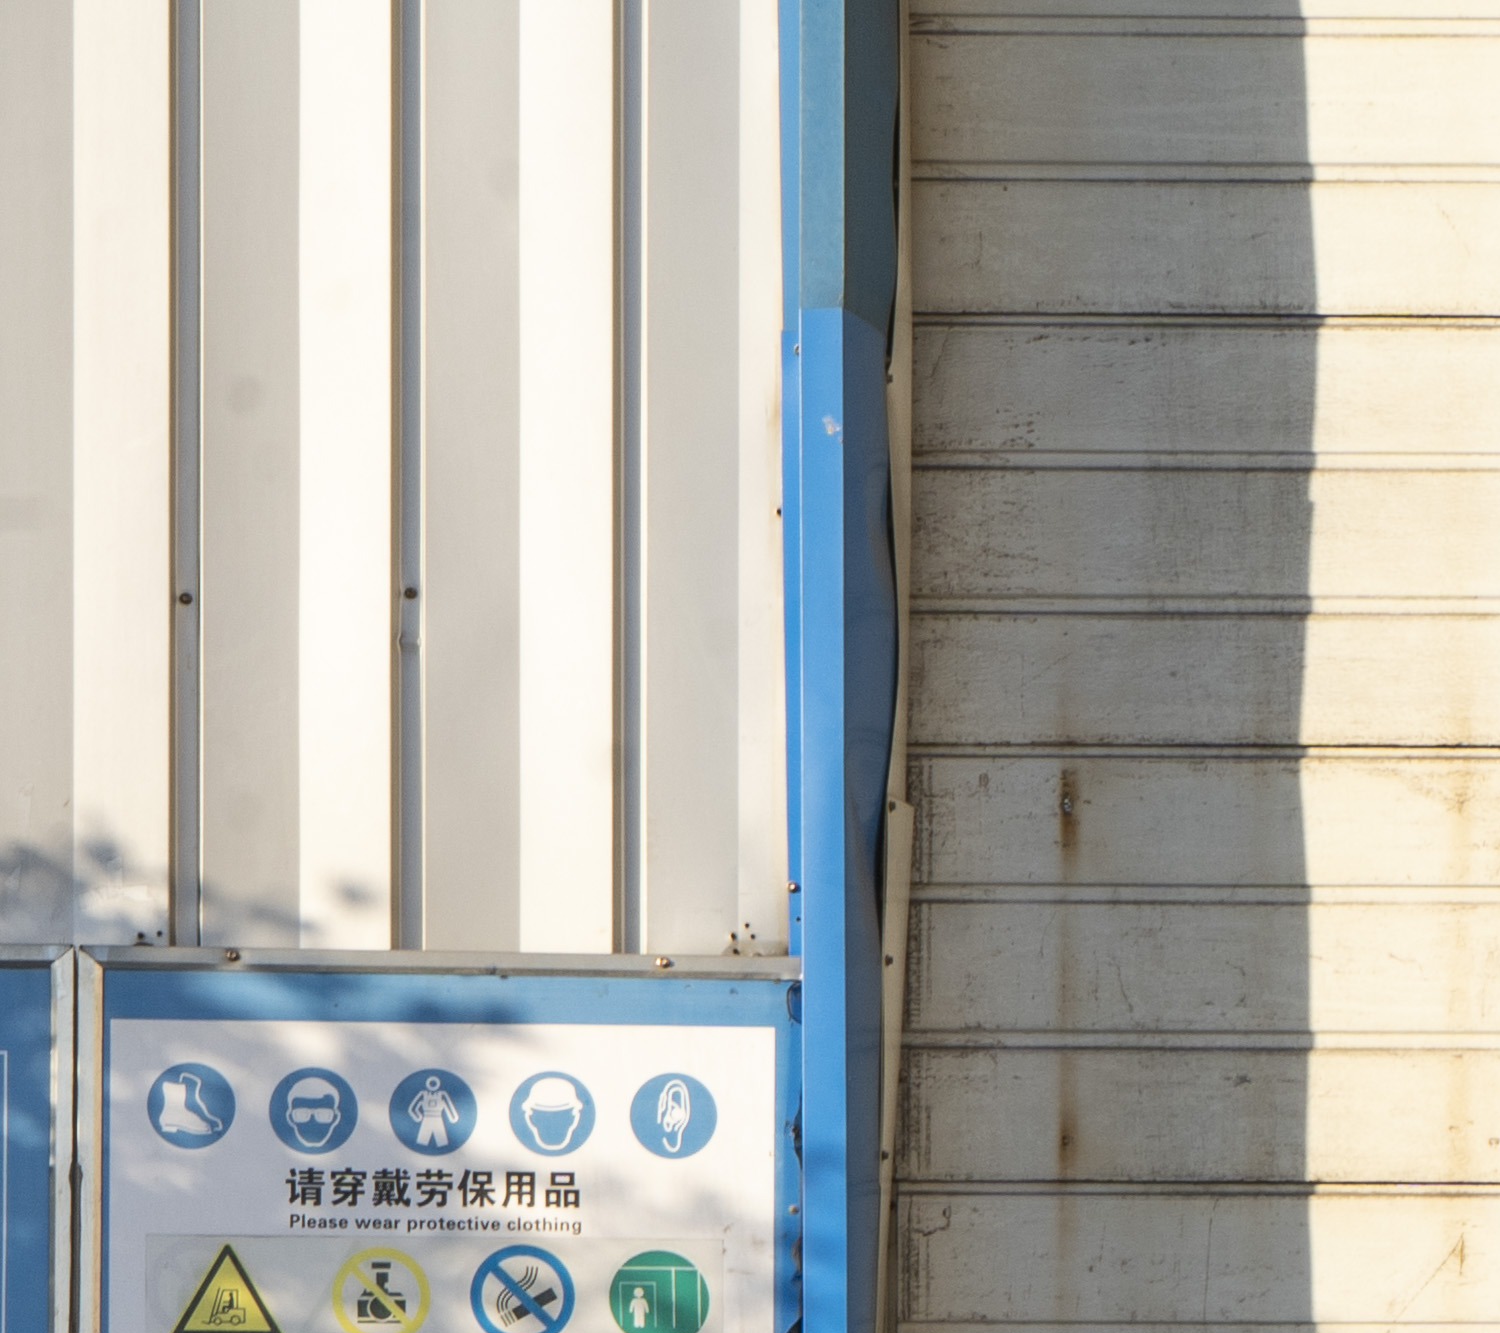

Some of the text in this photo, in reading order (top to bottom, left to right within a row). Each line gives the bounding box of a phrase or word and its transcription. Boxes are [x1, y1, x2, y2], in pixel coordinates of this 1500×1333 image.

[285, 1167, 581, 1208] 请穿戴劳保用品
[289, 1213, 583, 1236] Please wear protective clothing
